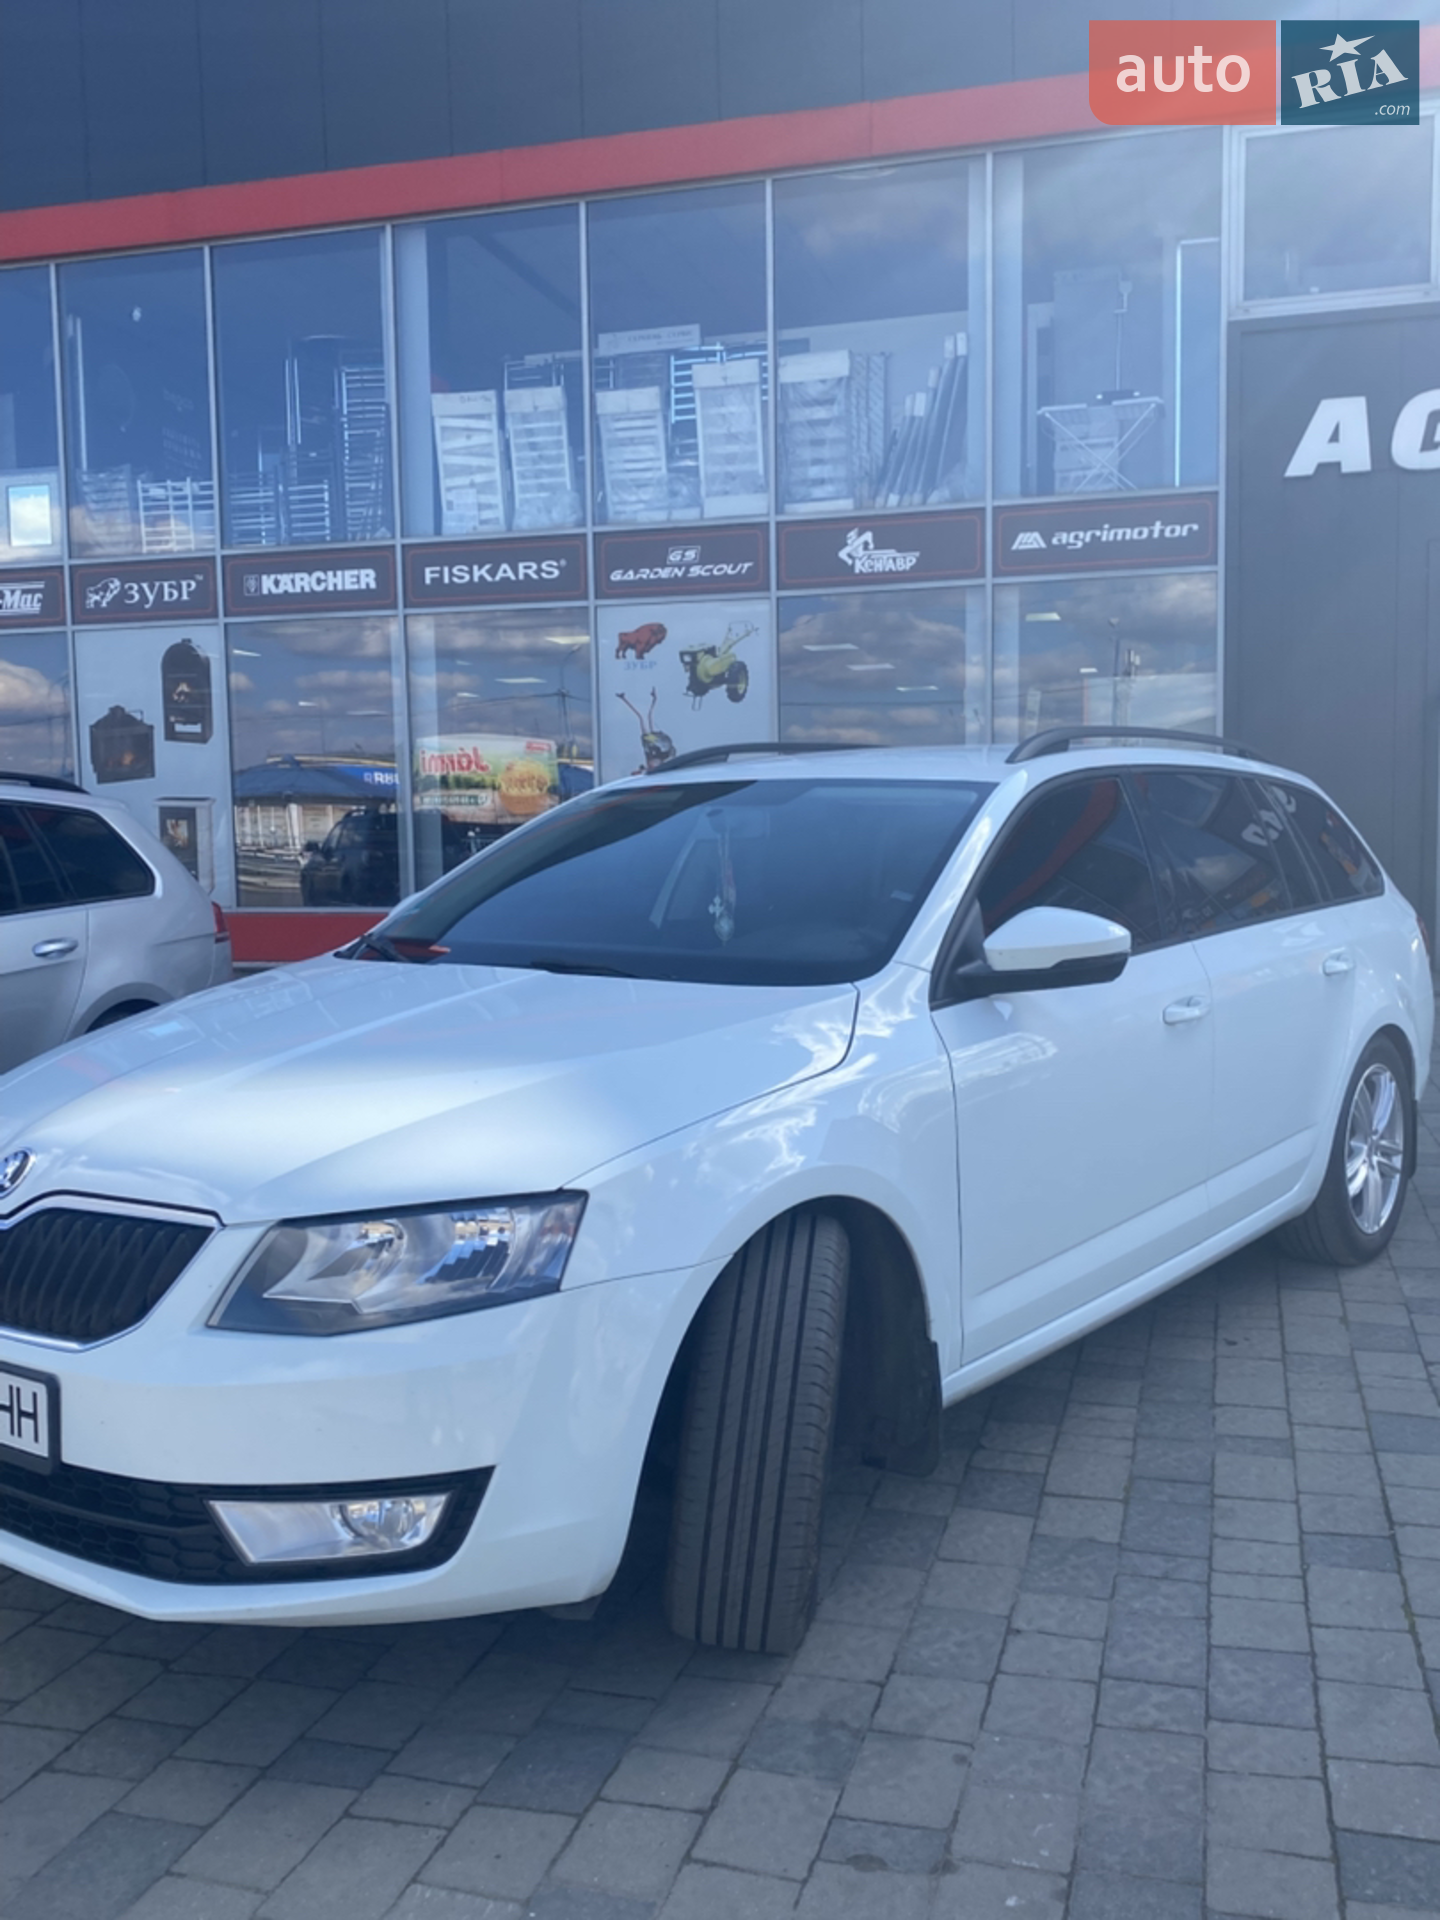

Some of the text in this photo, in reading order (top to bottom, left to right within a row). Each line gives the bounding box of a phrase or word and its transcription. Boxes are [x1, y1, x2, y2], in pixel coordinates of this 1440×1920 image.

[1051, 520, 1199, 550] agrimotor
[261, 568, 376, 595] KÄRCHER
[609, 561, 755, 582] GARDEN SCOUT
